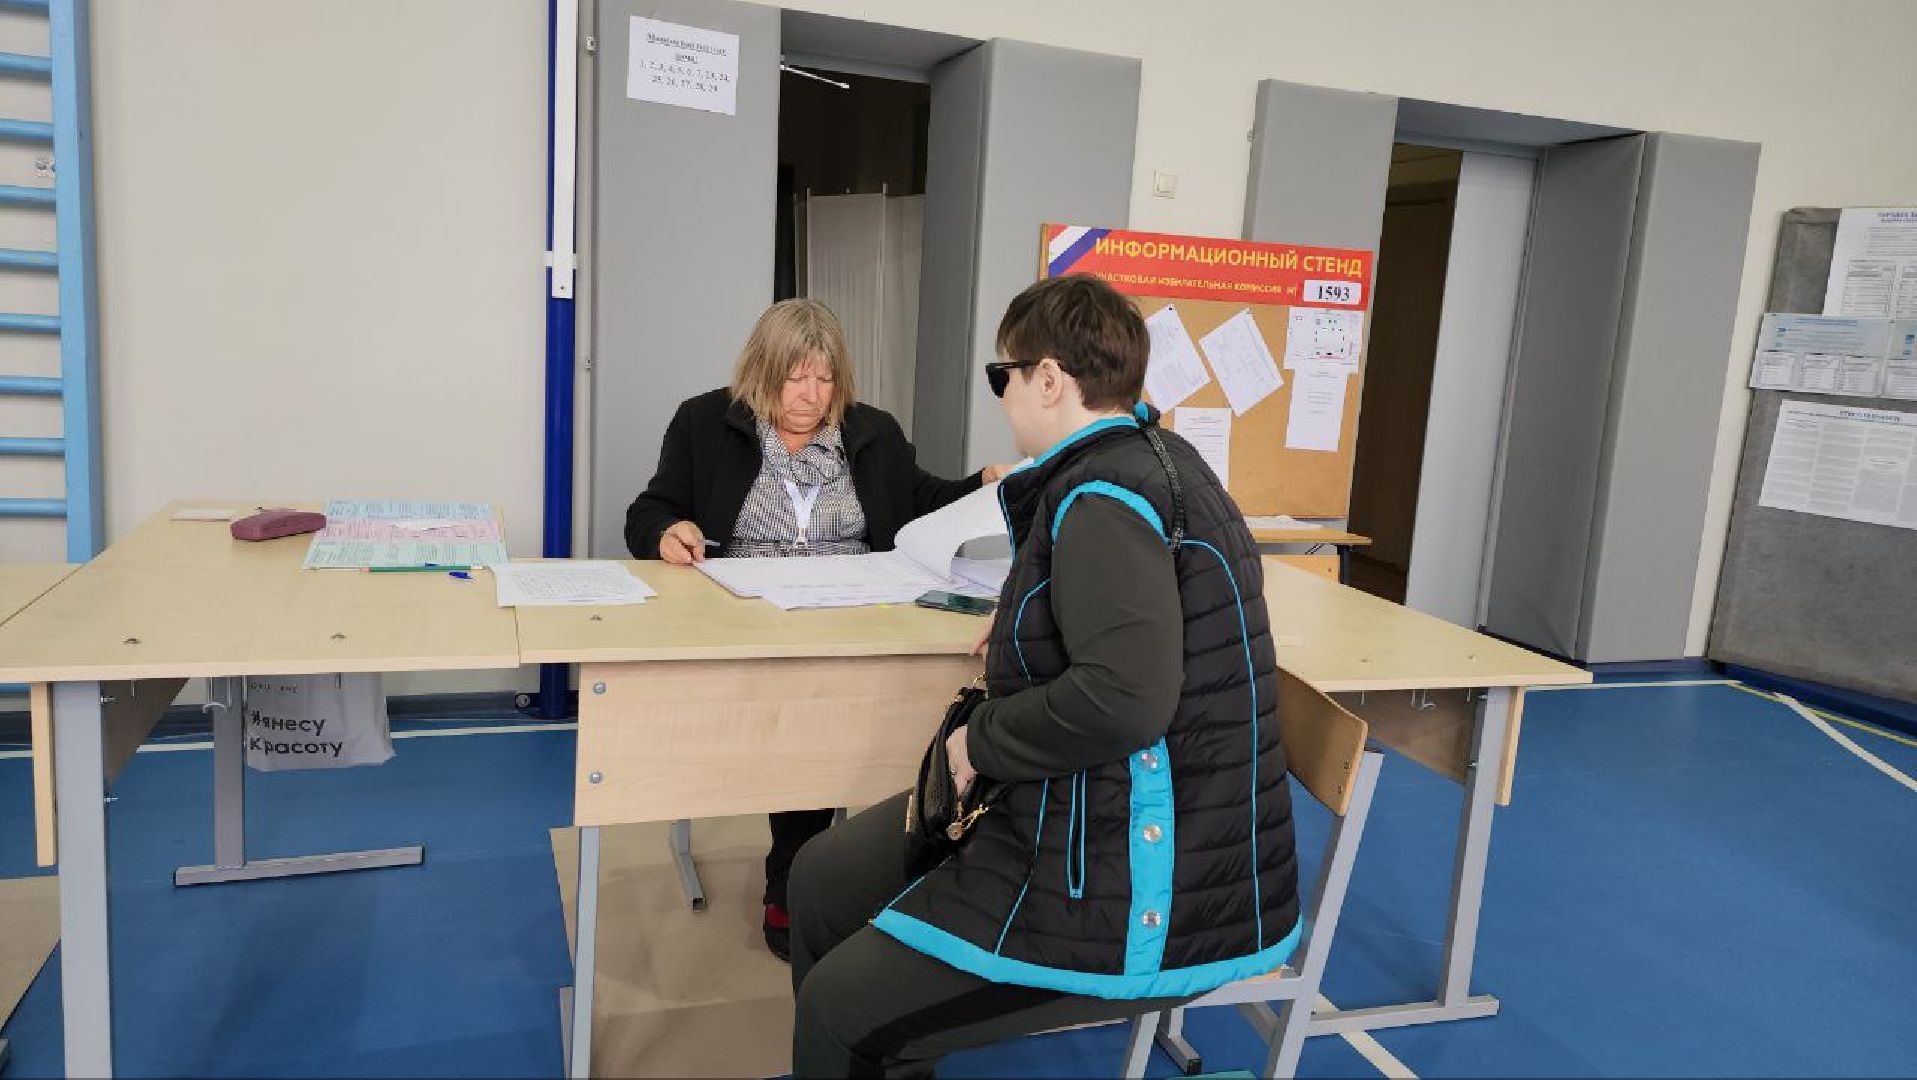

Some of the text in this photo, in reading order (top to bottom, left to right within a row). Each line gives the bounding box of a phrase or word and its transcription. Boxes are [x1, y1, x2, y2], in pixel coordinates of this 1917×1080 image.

[1095, 237, 1362, 278] ИНФОРМАЦИОННЫЙ СТЕНД
[1234, 282, 1282, 294] КОМИССИЯ
[1318, 285, 1350, 301] 1593
